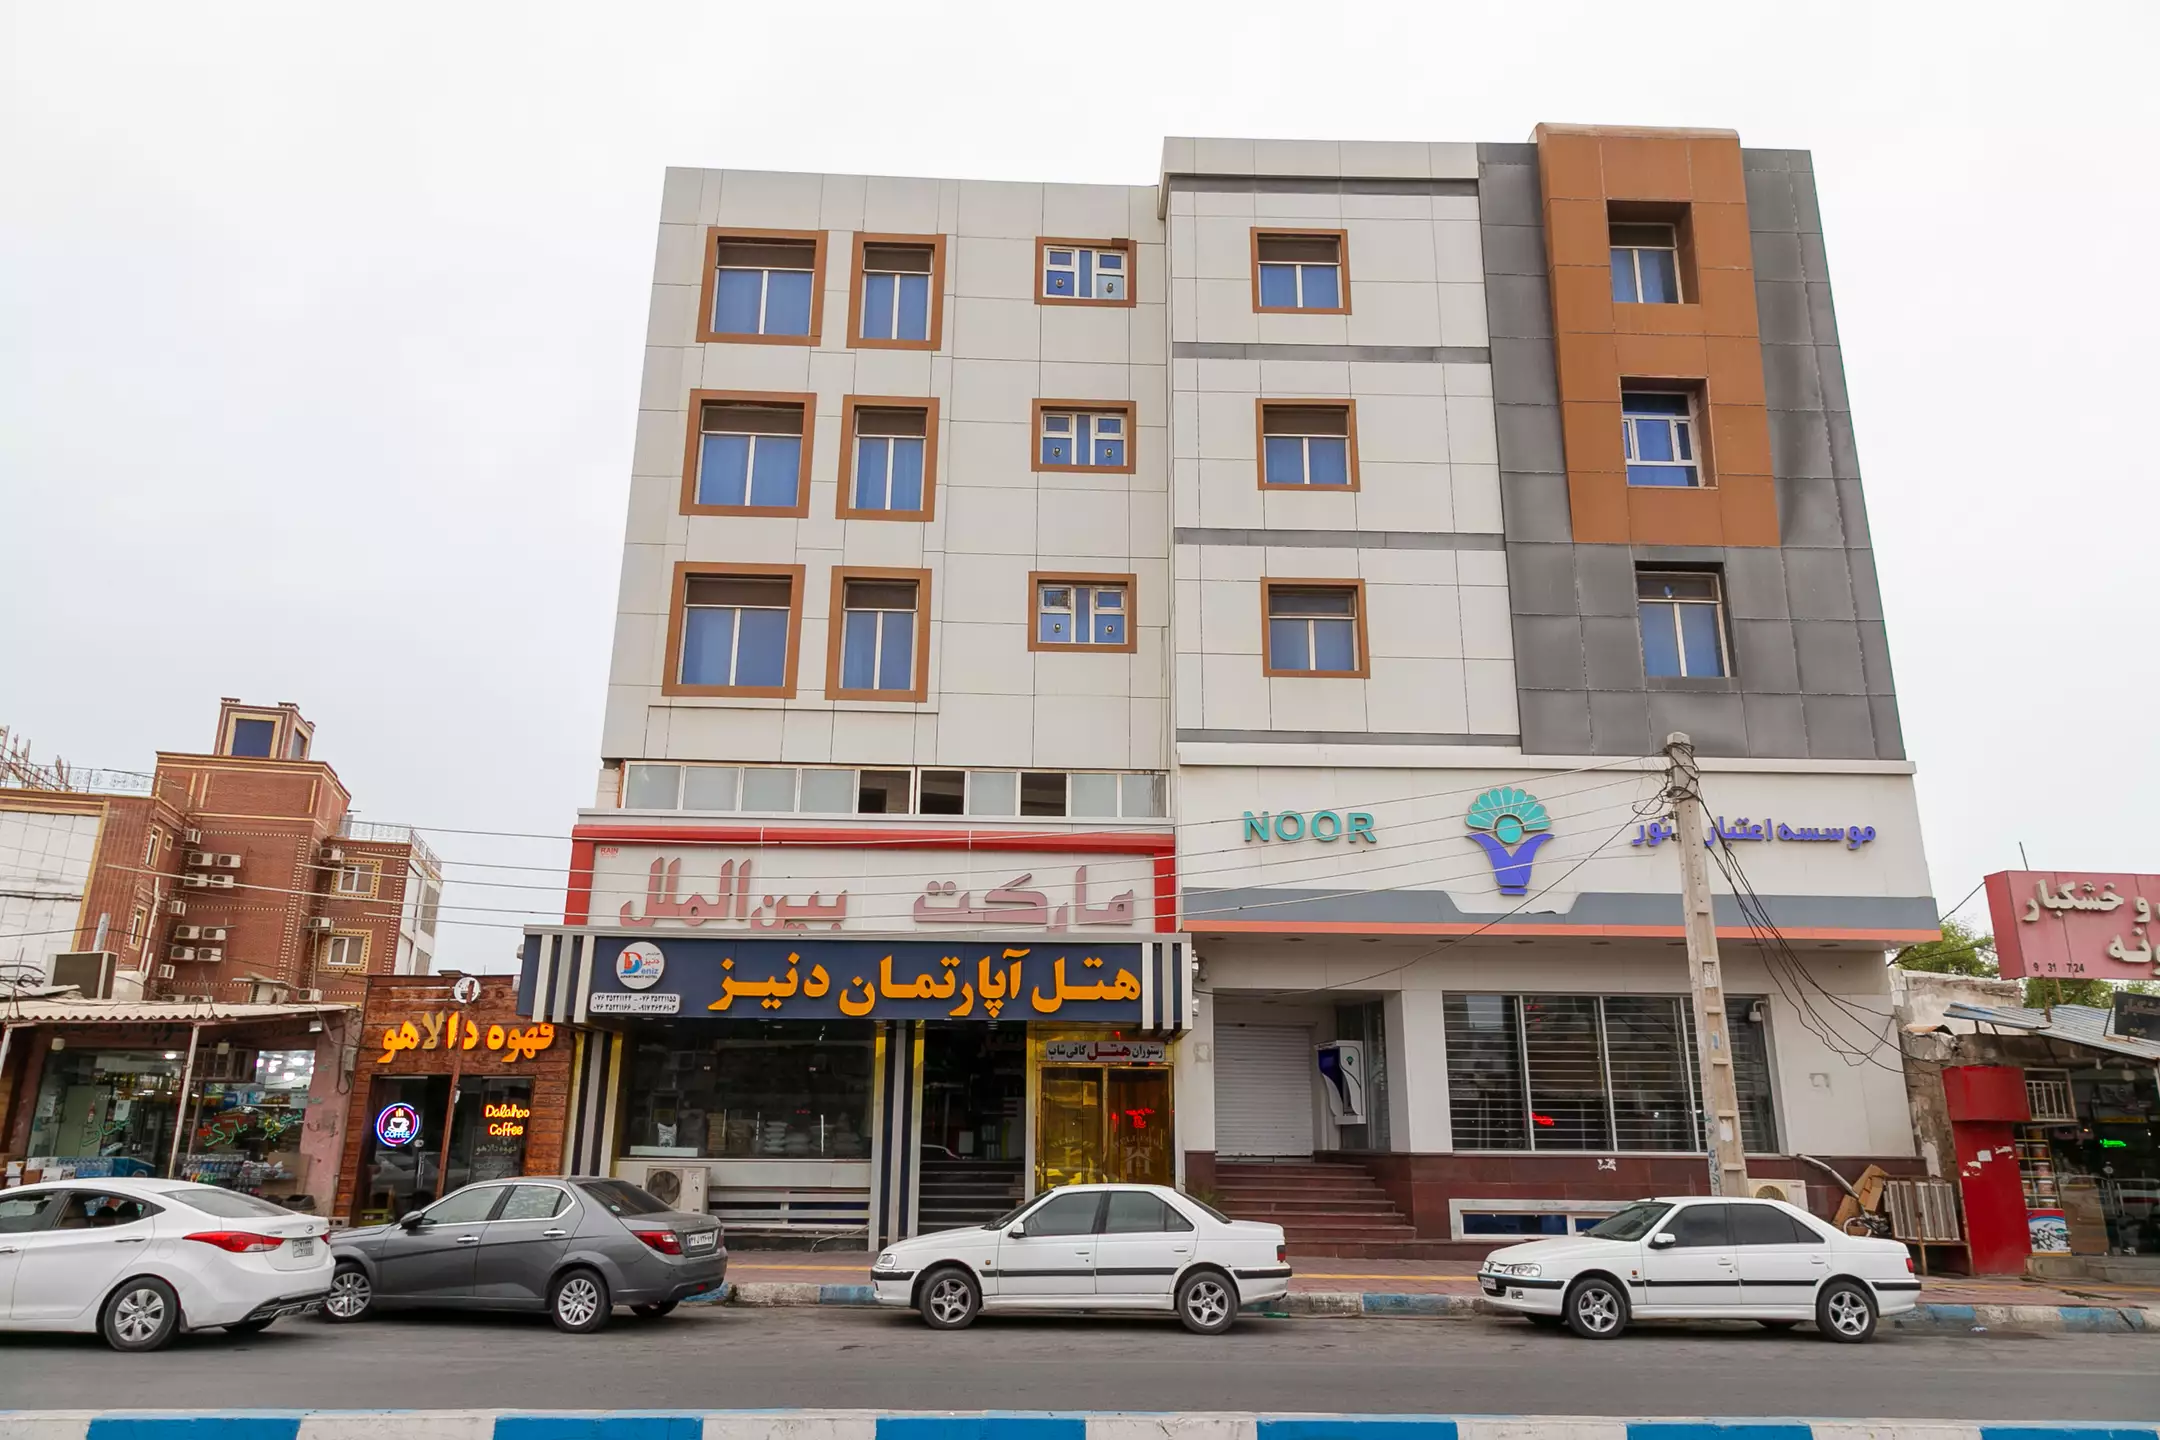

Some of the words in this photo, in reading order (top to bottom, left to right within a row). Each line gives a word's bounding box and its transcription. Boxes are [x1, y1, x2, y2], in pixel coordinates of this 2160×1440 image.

[1243, 810, 1377, 843] NOOR
[1632, 817, 1673, 848] نور
[1778, 823, 1876, 850] موسسه
[913, 865, 1133, 932] مارکت
[2022, 879, 2124, 922] خشکبار
[2133, 896, 2151, 923] و
[707, 952, 831, 1011] دنیز
[838, 948, 1031, 1018] آپارتمان
[1031, 957, 1141, 1013] هتل
[376, 1007, 480, 1063] دالاهو
[486, 1022, 555, 1063] قهوه
[1087, 1042, 1132, 1060] هتل
[1131, 1044, 1163, 1058] رستوران
[485, 1104, 530, 1118] Dalahoo
[384, 1130, 411, 1138] COFFEE
[488, 1122, 524, 1136] Coffee
